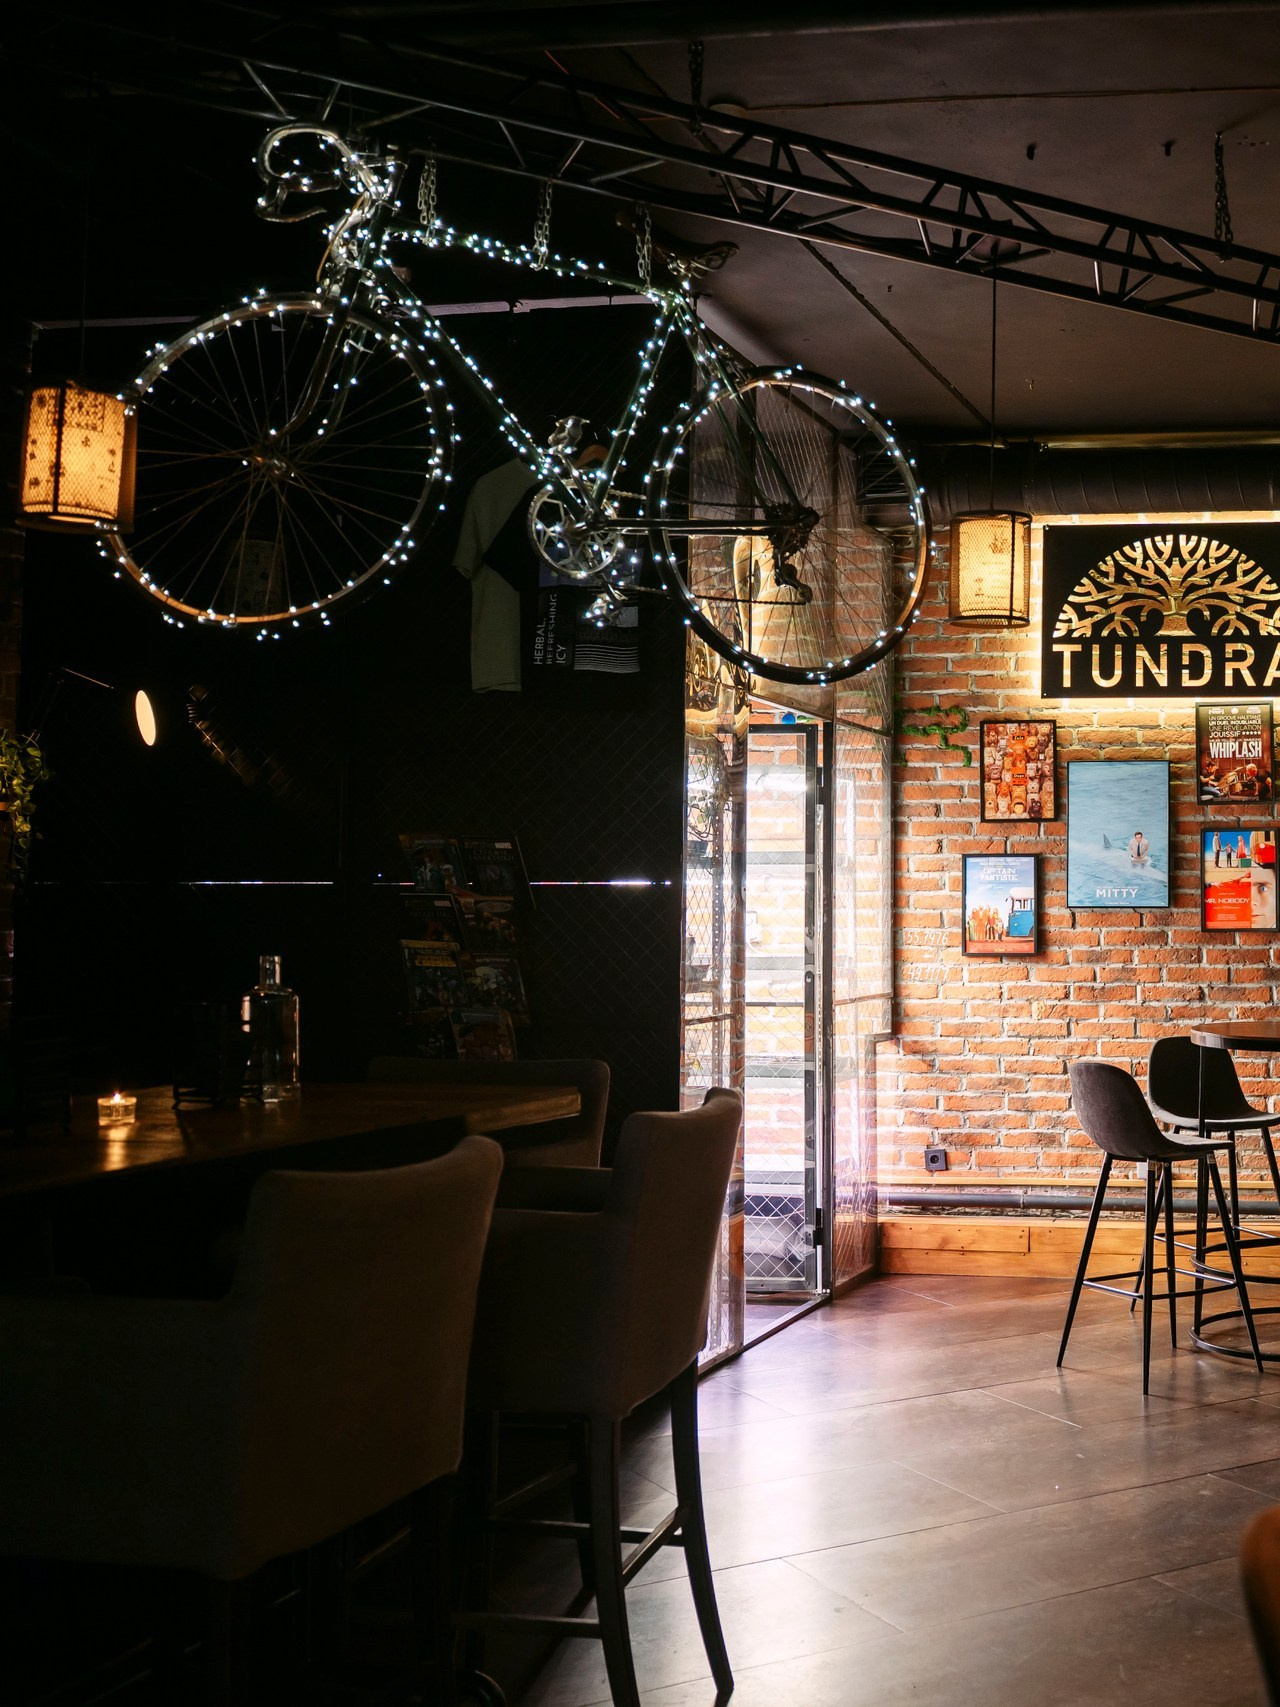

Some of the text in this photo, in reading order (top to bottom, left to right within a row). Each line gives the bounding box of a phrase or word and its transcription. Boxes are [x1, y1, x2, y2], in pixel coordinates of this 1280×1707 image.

[533, 617, 547, 665] HERBAL,
[555, 644, 567, 664] ICY
[1208, 730, 1241, 738] JOUISSIF
[1209, 741, 1262, 758] WHIPLASH
[1095, 888, 1139, 898] MITTY
